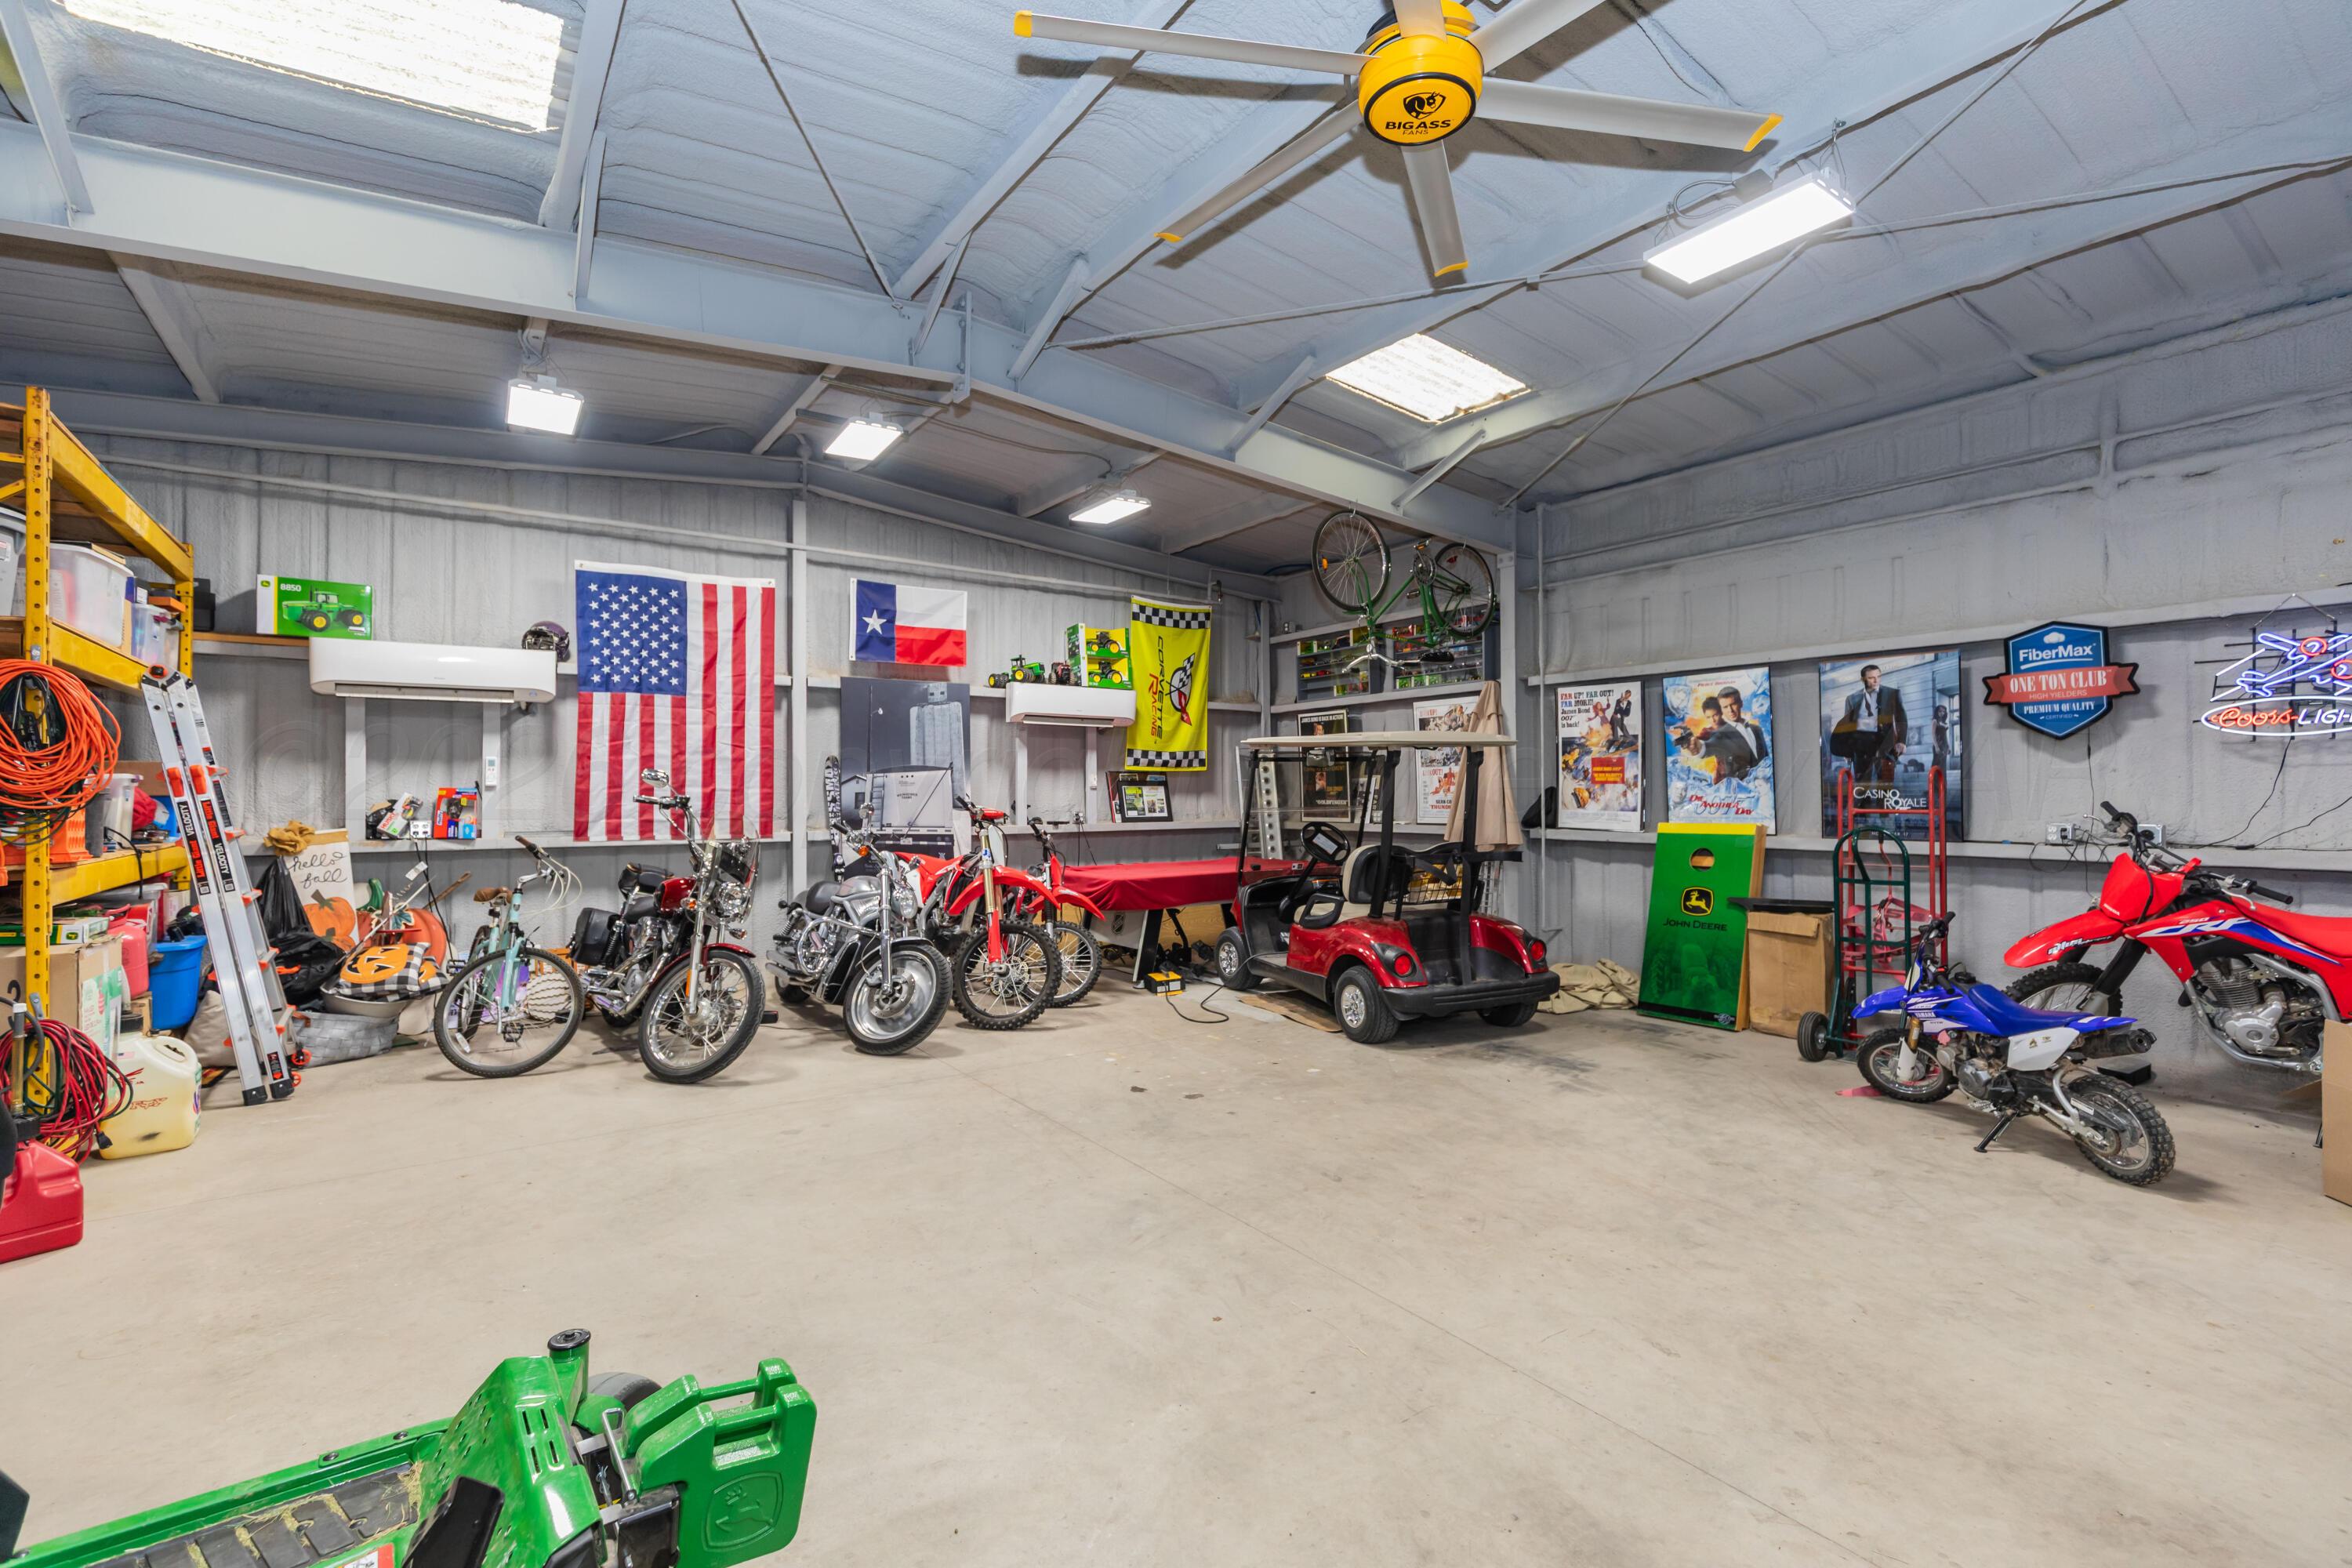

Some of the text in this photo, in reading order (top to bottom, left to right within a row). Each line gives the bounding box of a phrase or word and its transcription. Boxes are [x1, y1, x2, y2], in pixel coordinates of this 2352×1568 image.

[1385, 120, 1451, 129] BIG ASS
[280, 583, 302, 592] 8850
[2019, 644, 2093, 662] FiberMax
[2010, 670, 2107, 694] ONE TON CLUB
[2050, 690, 2088, 699] YIELDERS
[1148, 673, 1159, 738] RACING
[2024, 701, 2095, 714] PREMIUM QUALITY
[2298, 709, 2352, 725] LIGH
[1853, 786, 1900, 799] CASINO
[1884, 797, 1927, 809] ROYALE
[179, 804, 193, 837] VELOCITY
[202, 801, 230, 877] Little Giant VELOCITY
[189, 840, 205, 878] Little Giant
[289, 852, 345, 872] hello
[300, 869, 347, 889] fall
[1663, 918, 1728, 931] JOHN DEERE
[2136, 916, 2252, 938] CRF
